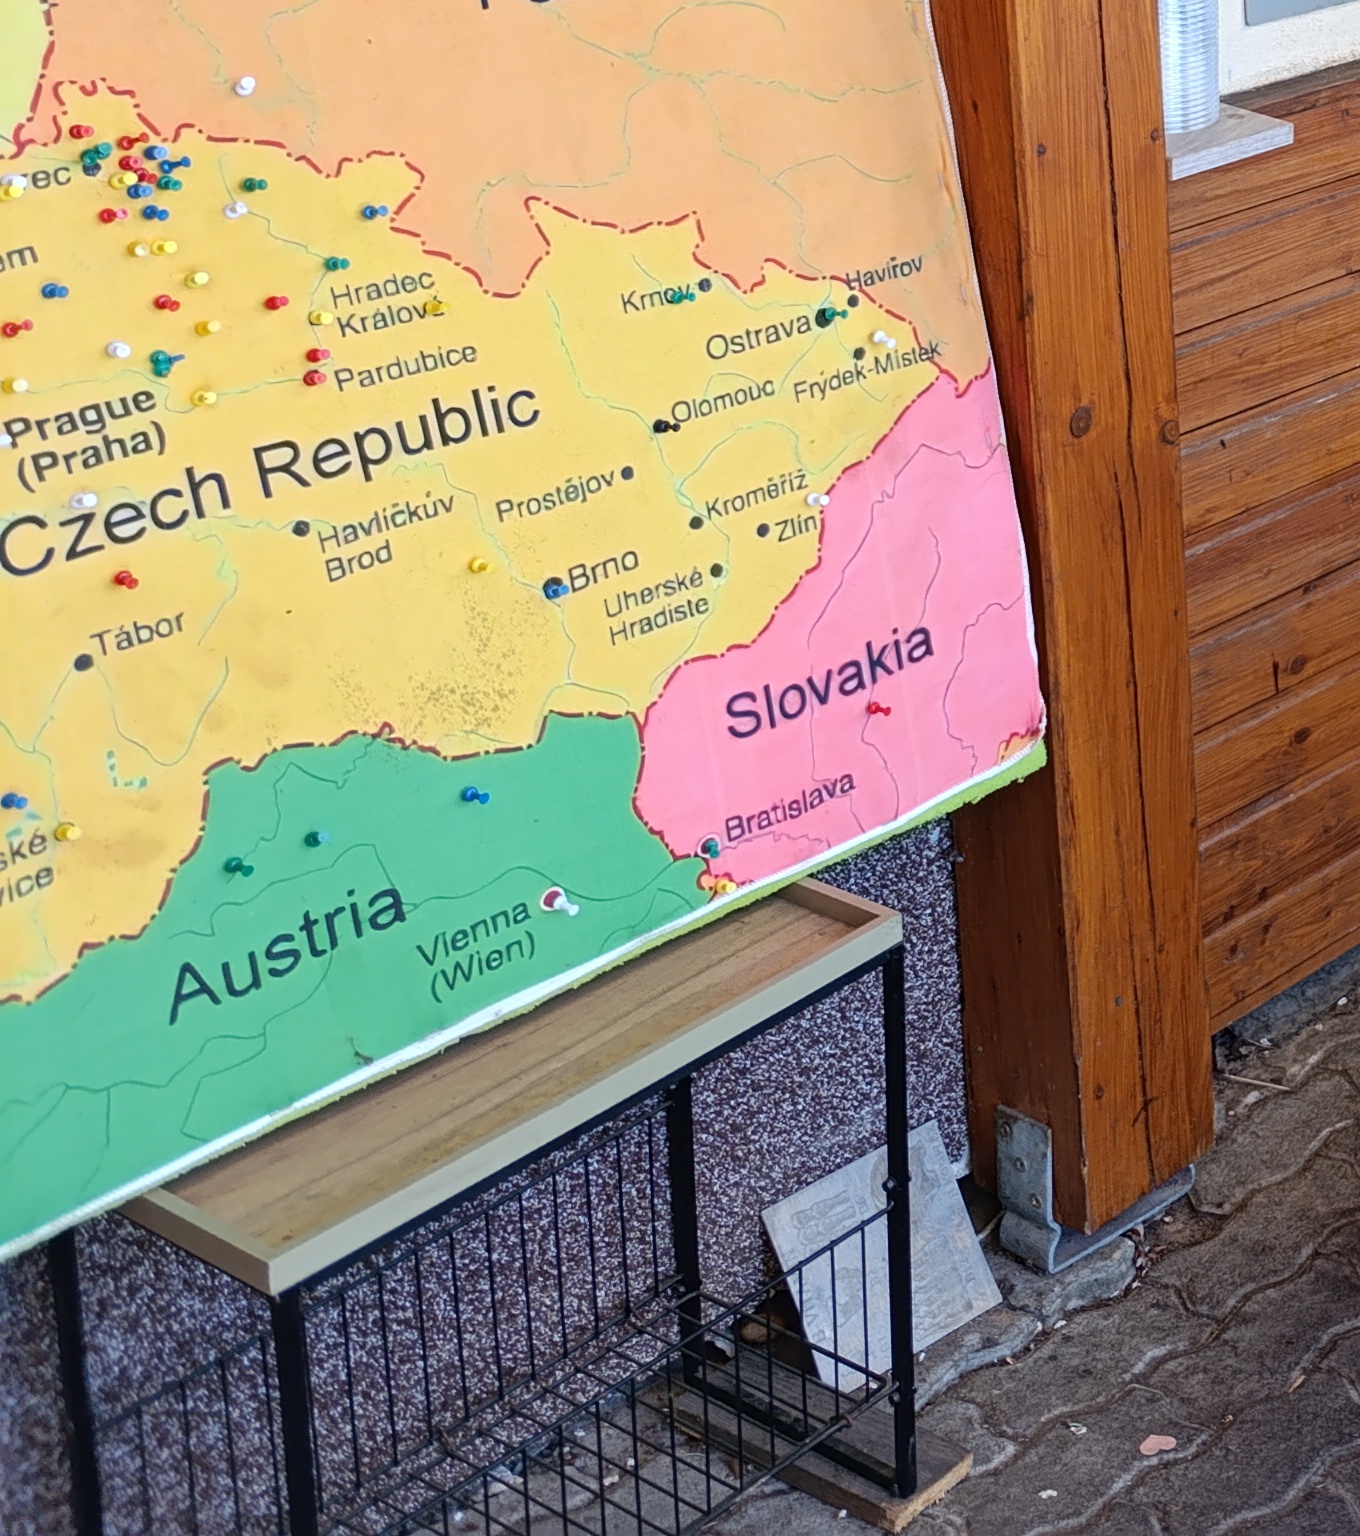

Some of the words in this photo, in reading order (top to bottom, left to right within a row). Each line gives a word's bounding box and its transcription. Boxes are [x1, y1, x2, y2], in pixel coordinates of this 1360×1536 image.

[330, 269, 437, 309] Hradec
[706, 314, 814, 362] Ostrava
[334, 342, 479, 392] Pardubice
[3, 388, 157, 449] Prague
[671, 378, 777, 426] Olomouc
[0, 465, 232, 578] Czech
[253, 385, 542, 500] Republic
[17, 421, 167, 494] (Praha)
[495, 467, 616, 524] Prostějov
[325, 540, 393, 583] Brod
[568, 549, 641, 595] Brno
[603, 566, 704, 619] Uherské
[89, 611, 187, 658] Tábor
[724, 624, 936, 741] Slovakia
[724, 767, 859, 843] Bratislava
[167, 886, 407, 1027] Austria
[416, 899, 532, 968] Vienna
[429, 930, 537, 1006] (Wien)
